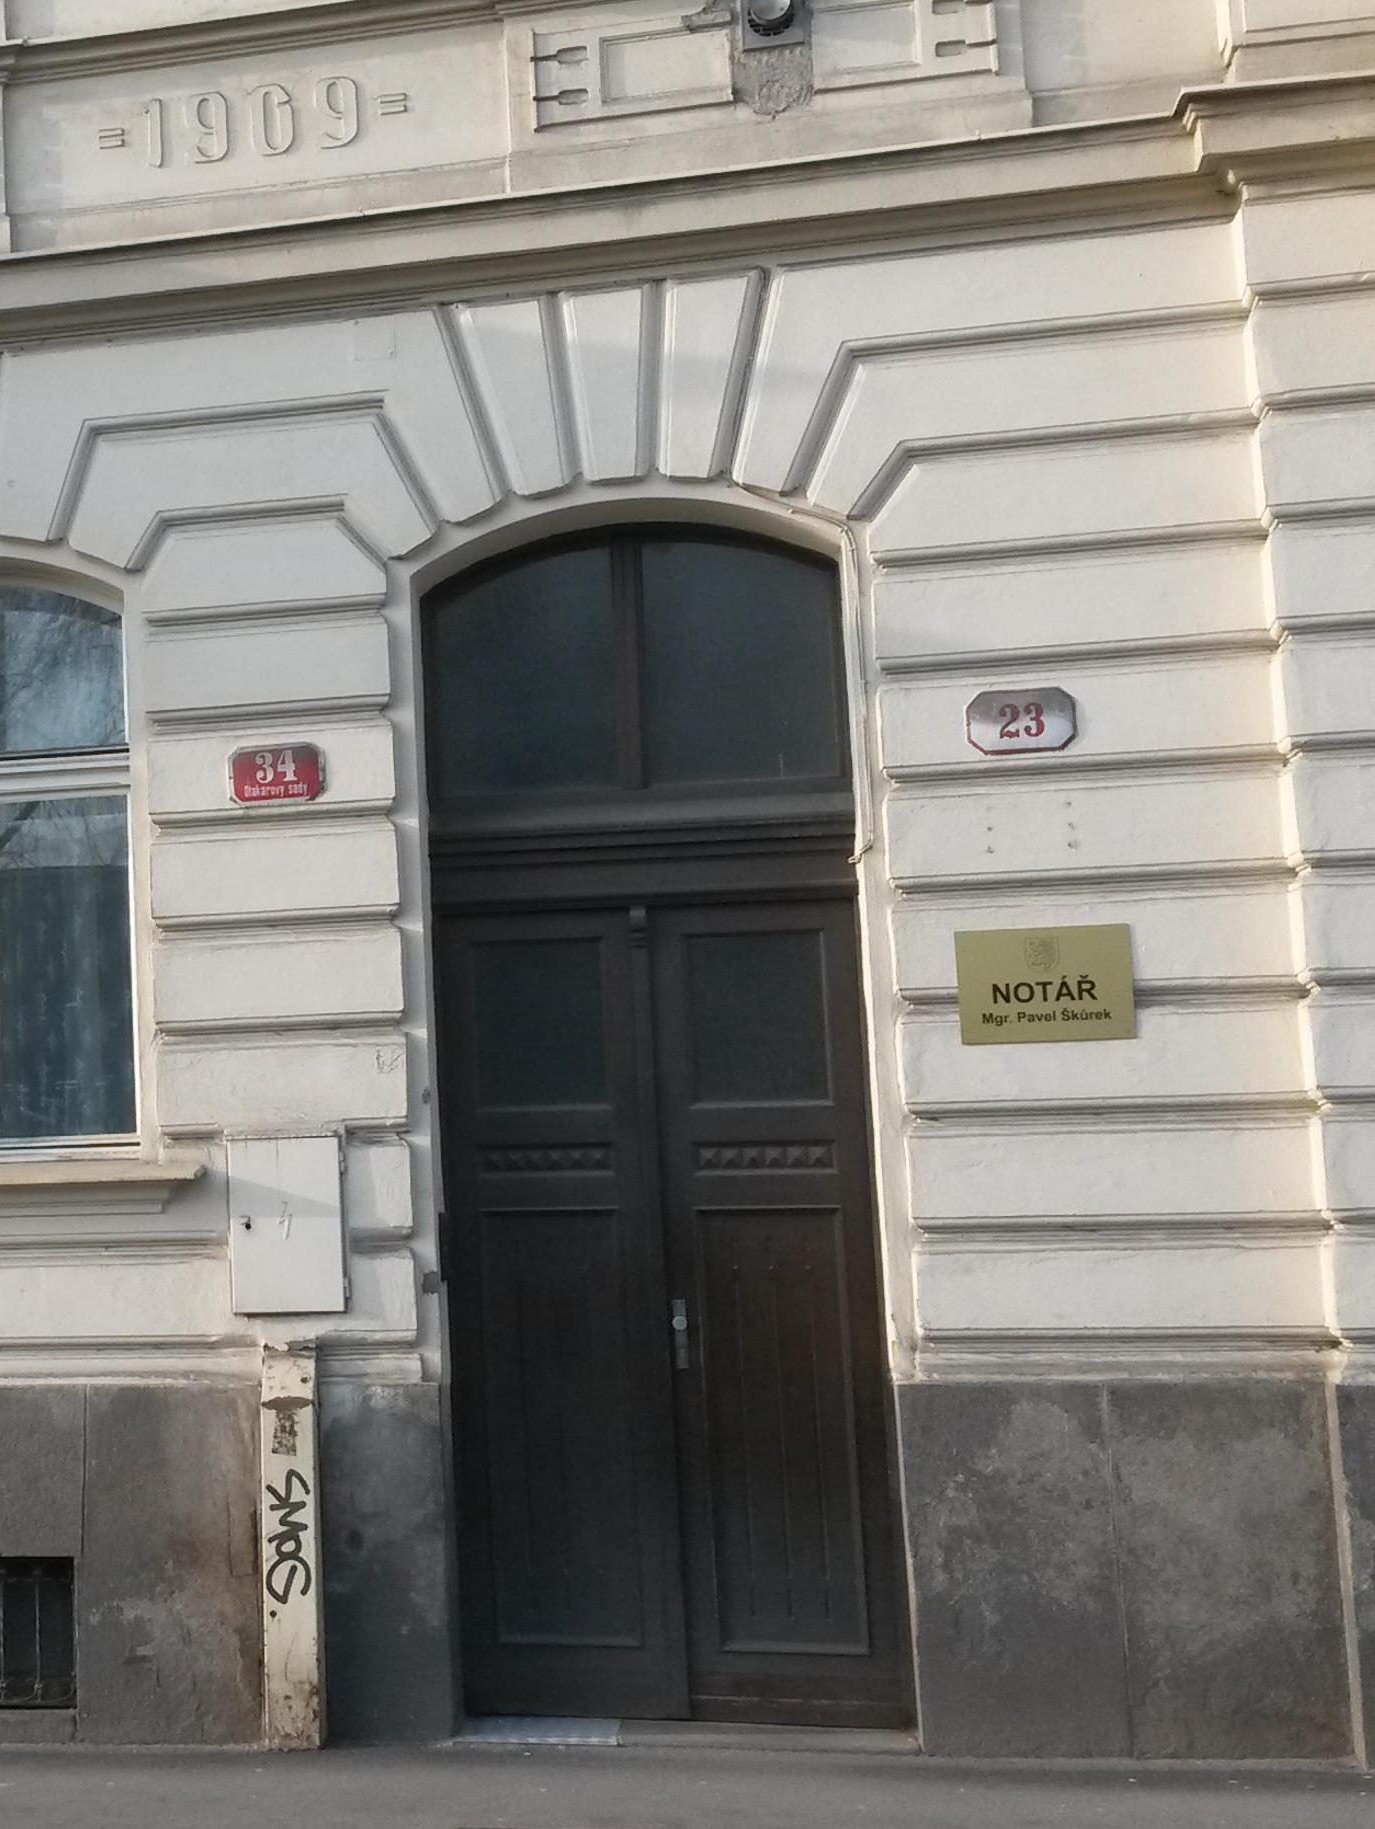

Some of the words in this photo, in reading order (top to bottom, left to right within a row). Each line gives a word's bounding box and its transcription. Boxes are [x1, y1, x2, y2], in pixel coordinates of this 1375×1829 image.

[142, 76, 360, 169] 1909
[999, 702, 1045, 739] 23
[255, 749, 298, 783] 34
[244, 785, 284, 798] Otakarovy
[289, 781, 308, 796] sady
[992, 974, 1098, 1004] NOTÁŘ
[982, 1012, 1014, 1027] Mgr.
[1017, 1010, 1057, 1023] Pavel
[1061, 1007, 1113, 1022] Škůrek
